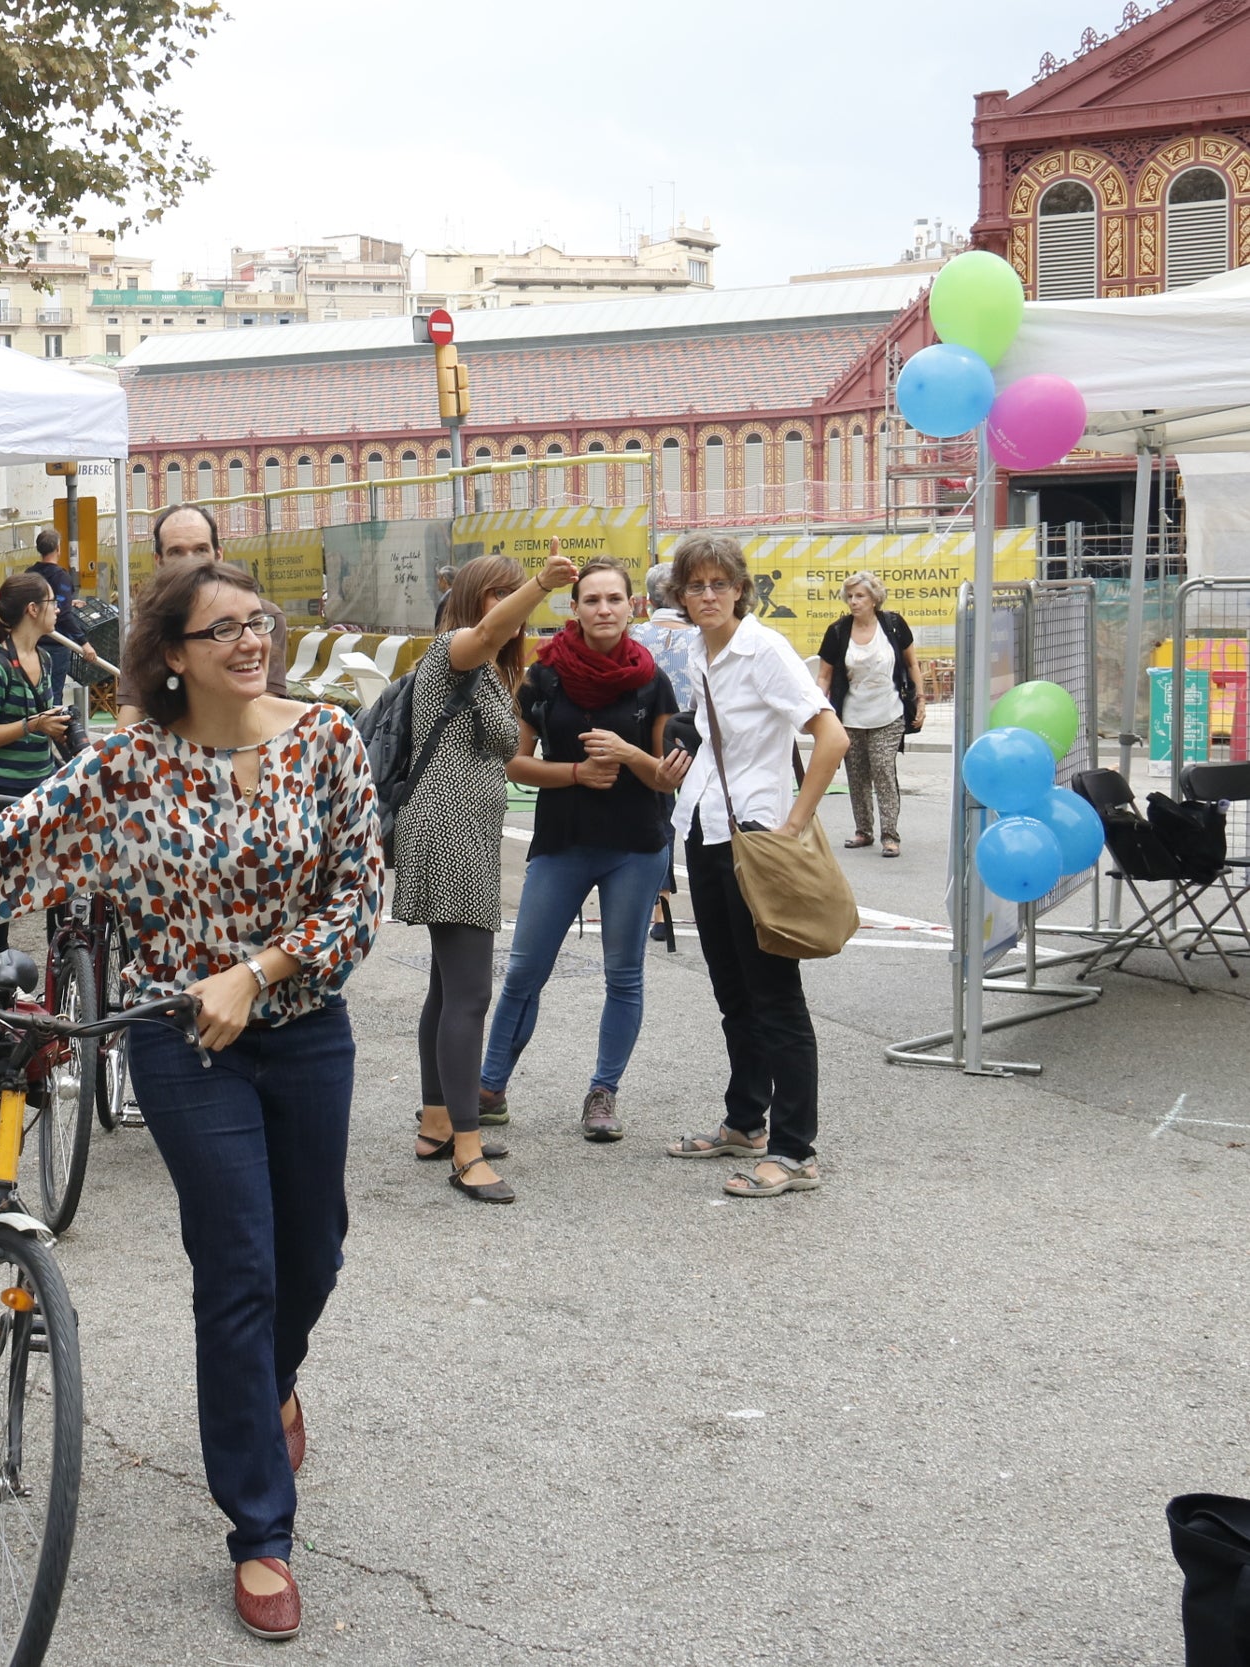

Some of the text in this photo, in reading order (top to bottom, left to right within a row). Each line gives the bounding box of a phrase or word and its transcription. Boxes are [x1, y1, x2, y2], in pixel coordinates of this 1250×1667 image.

[514, 538, 606, 551] ESTEM RORMANT
[523, 557, 548, 568] MERC
[806, 567, 959, 582] ESTEM EFORMANT
[807, 588, 825, 601] EL
[894, 588, 915, 599] DE
[918, 587, 959, 598] SANT
[806, 610, 837, 618] Fases:
[907, 608, 948, 617] acabats
